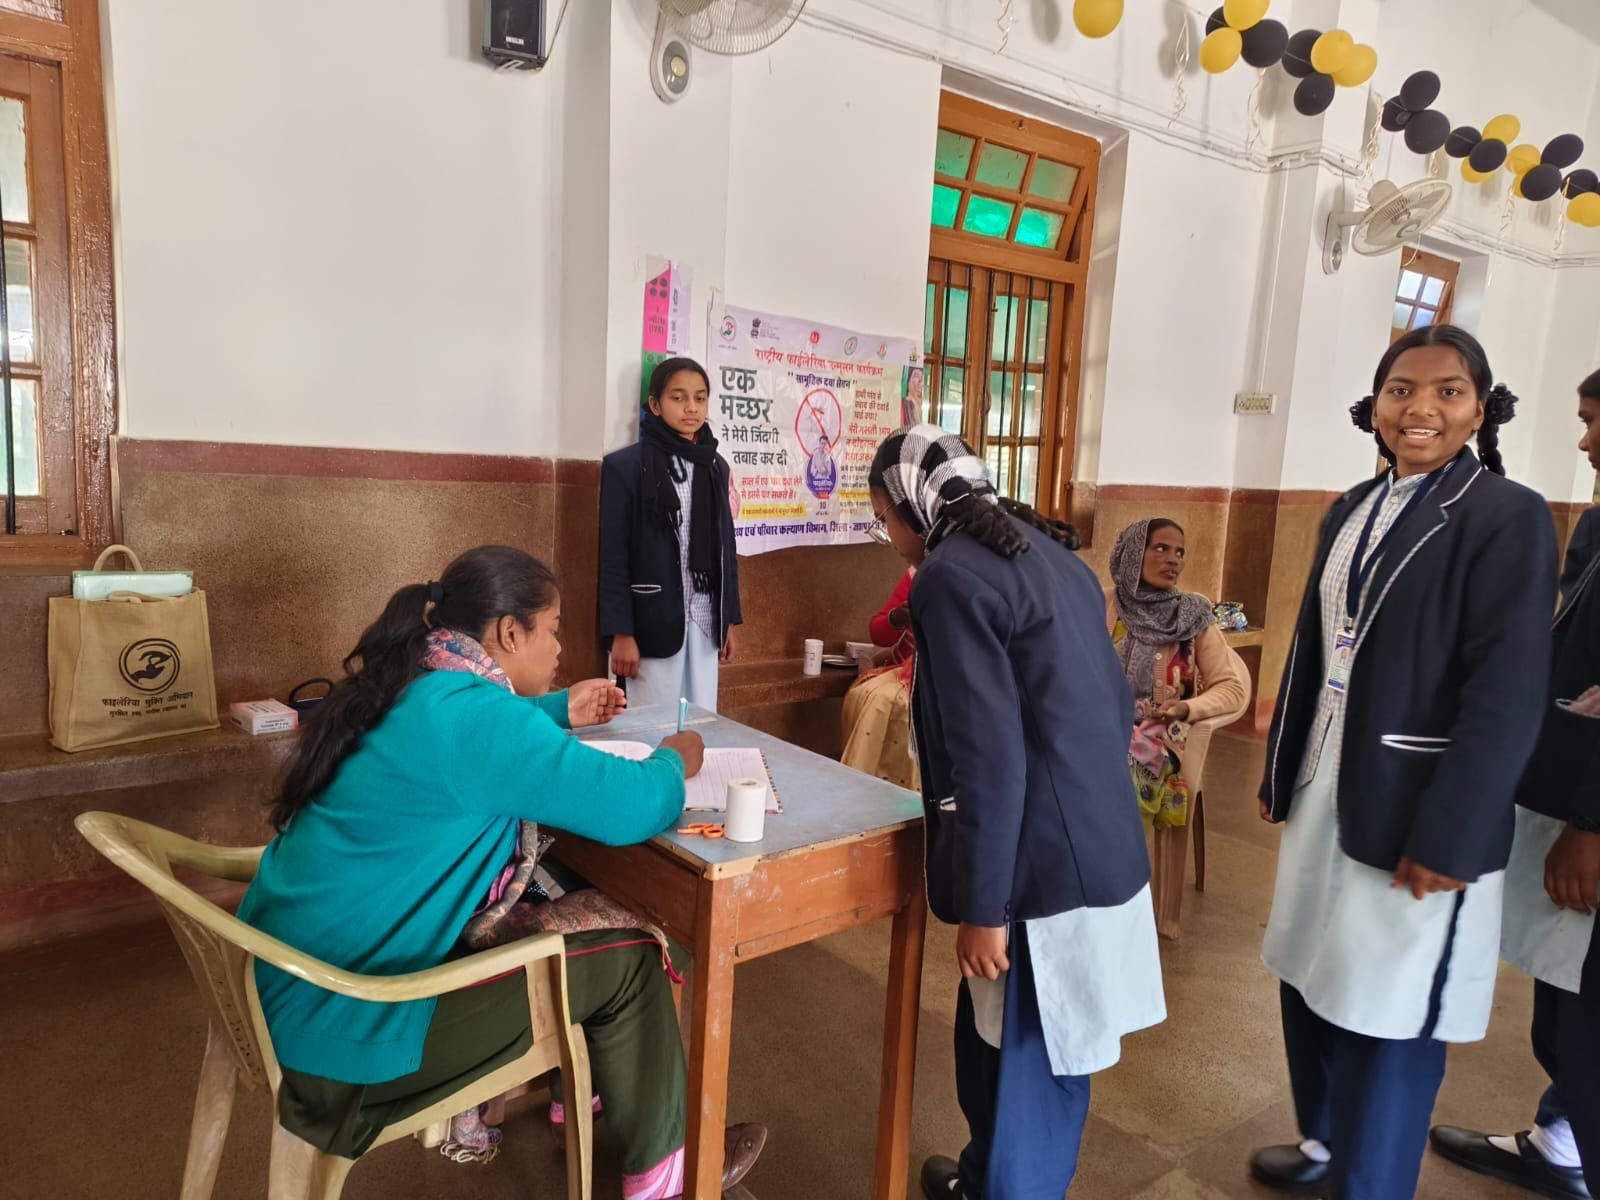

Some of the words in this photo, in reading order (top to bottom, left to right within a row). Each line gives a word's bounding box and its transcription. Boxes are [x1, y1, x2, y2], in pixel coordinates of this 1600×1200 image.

[719, 366, 757, 394] एक
[719, 394, 773, 423] मच्छर
[721, 424, 729, 442] ने
[732, 424, 748, 442] मेरी
[750, 424, 780, 444] जिंदगी
[760, 451, 774, 465] कर
[776, 448, 788, 466] दी
[744, 523, 756, 537] एवं
[757, 523, 778, 536] परिवार
[780, 523, 804, 535] कल्याण
